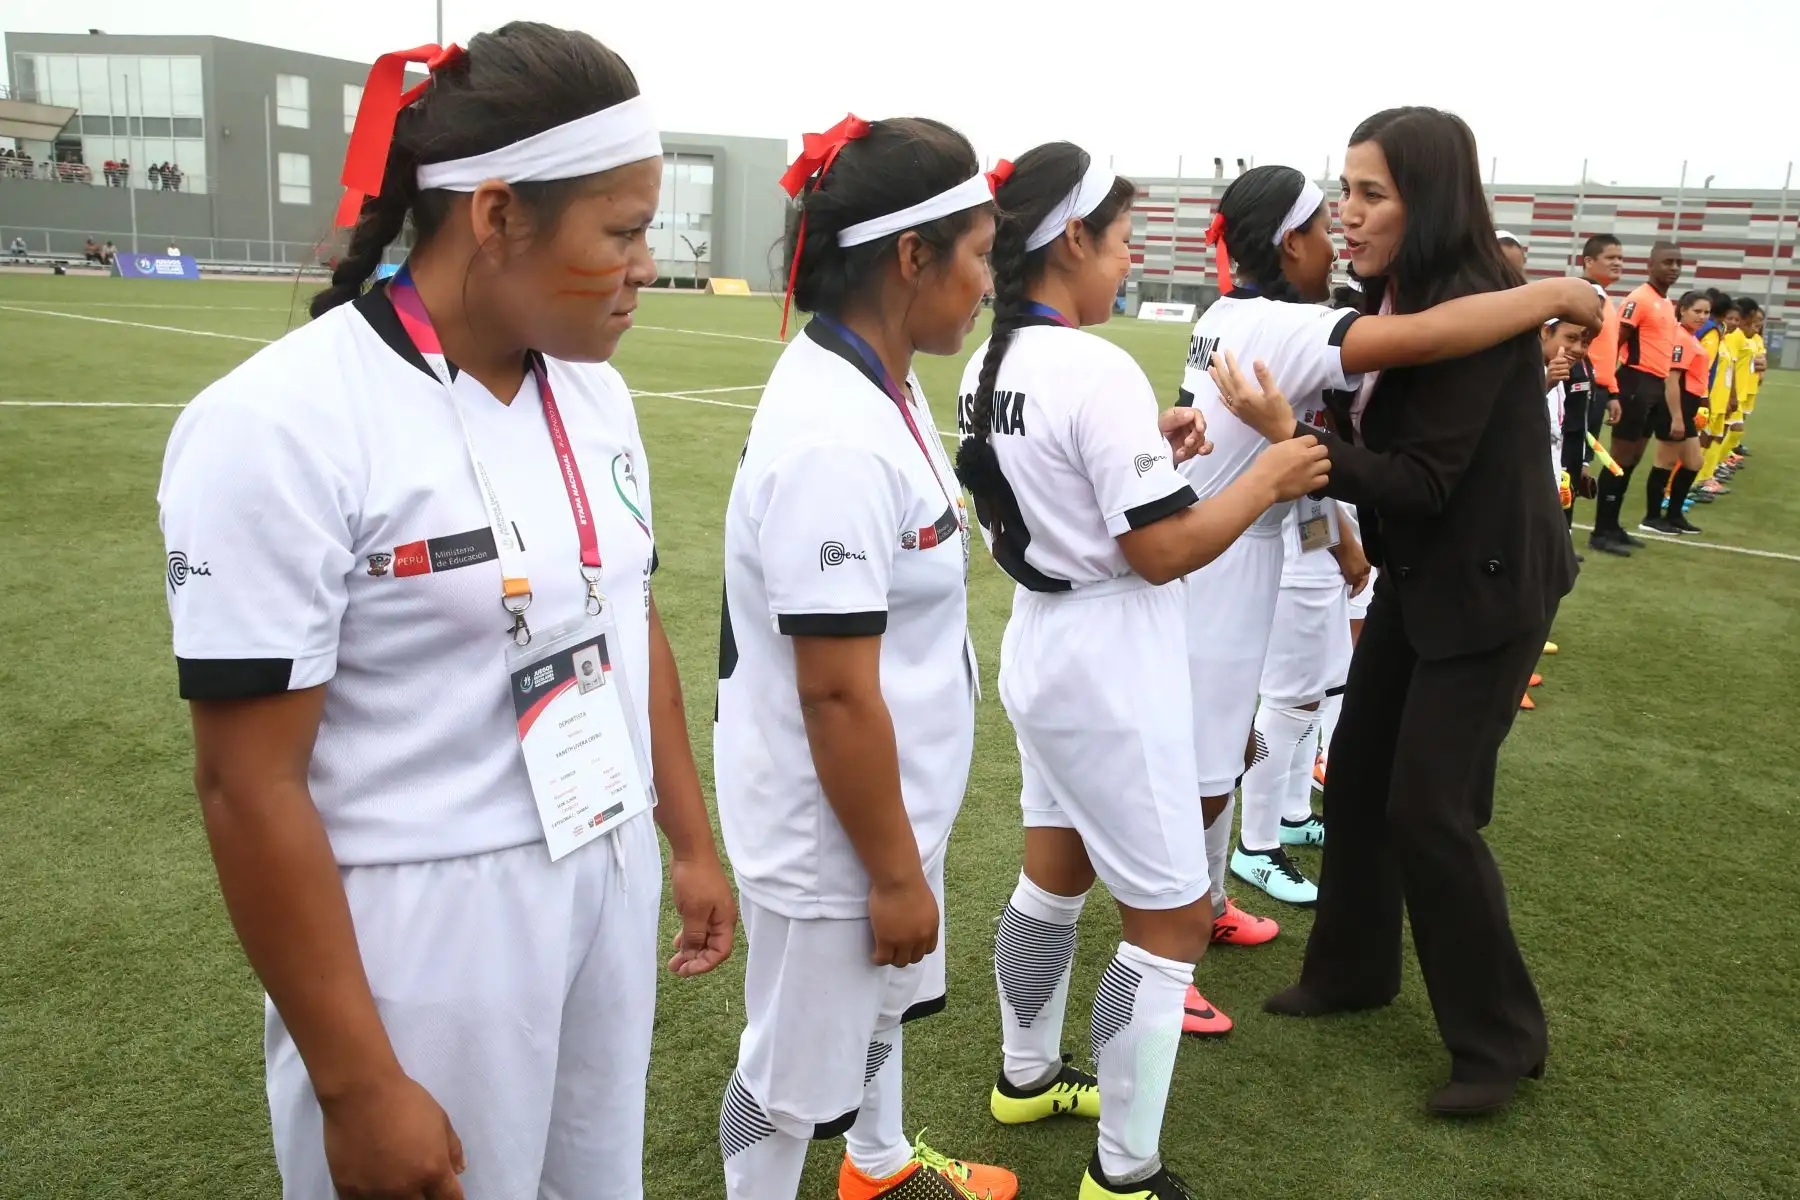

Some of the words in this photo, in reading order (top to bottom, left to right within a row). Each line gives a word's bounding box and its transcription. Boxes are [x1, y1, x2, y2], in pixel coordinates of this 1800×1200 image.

[562, 453, 579, 497] NACIONAL
[576, 497, 587, 525] ETAPA
[435, 545, 475, 559] Ministerio
[449, 551, 488, 566] Educación
[820, 541, 866, 571] Perú
